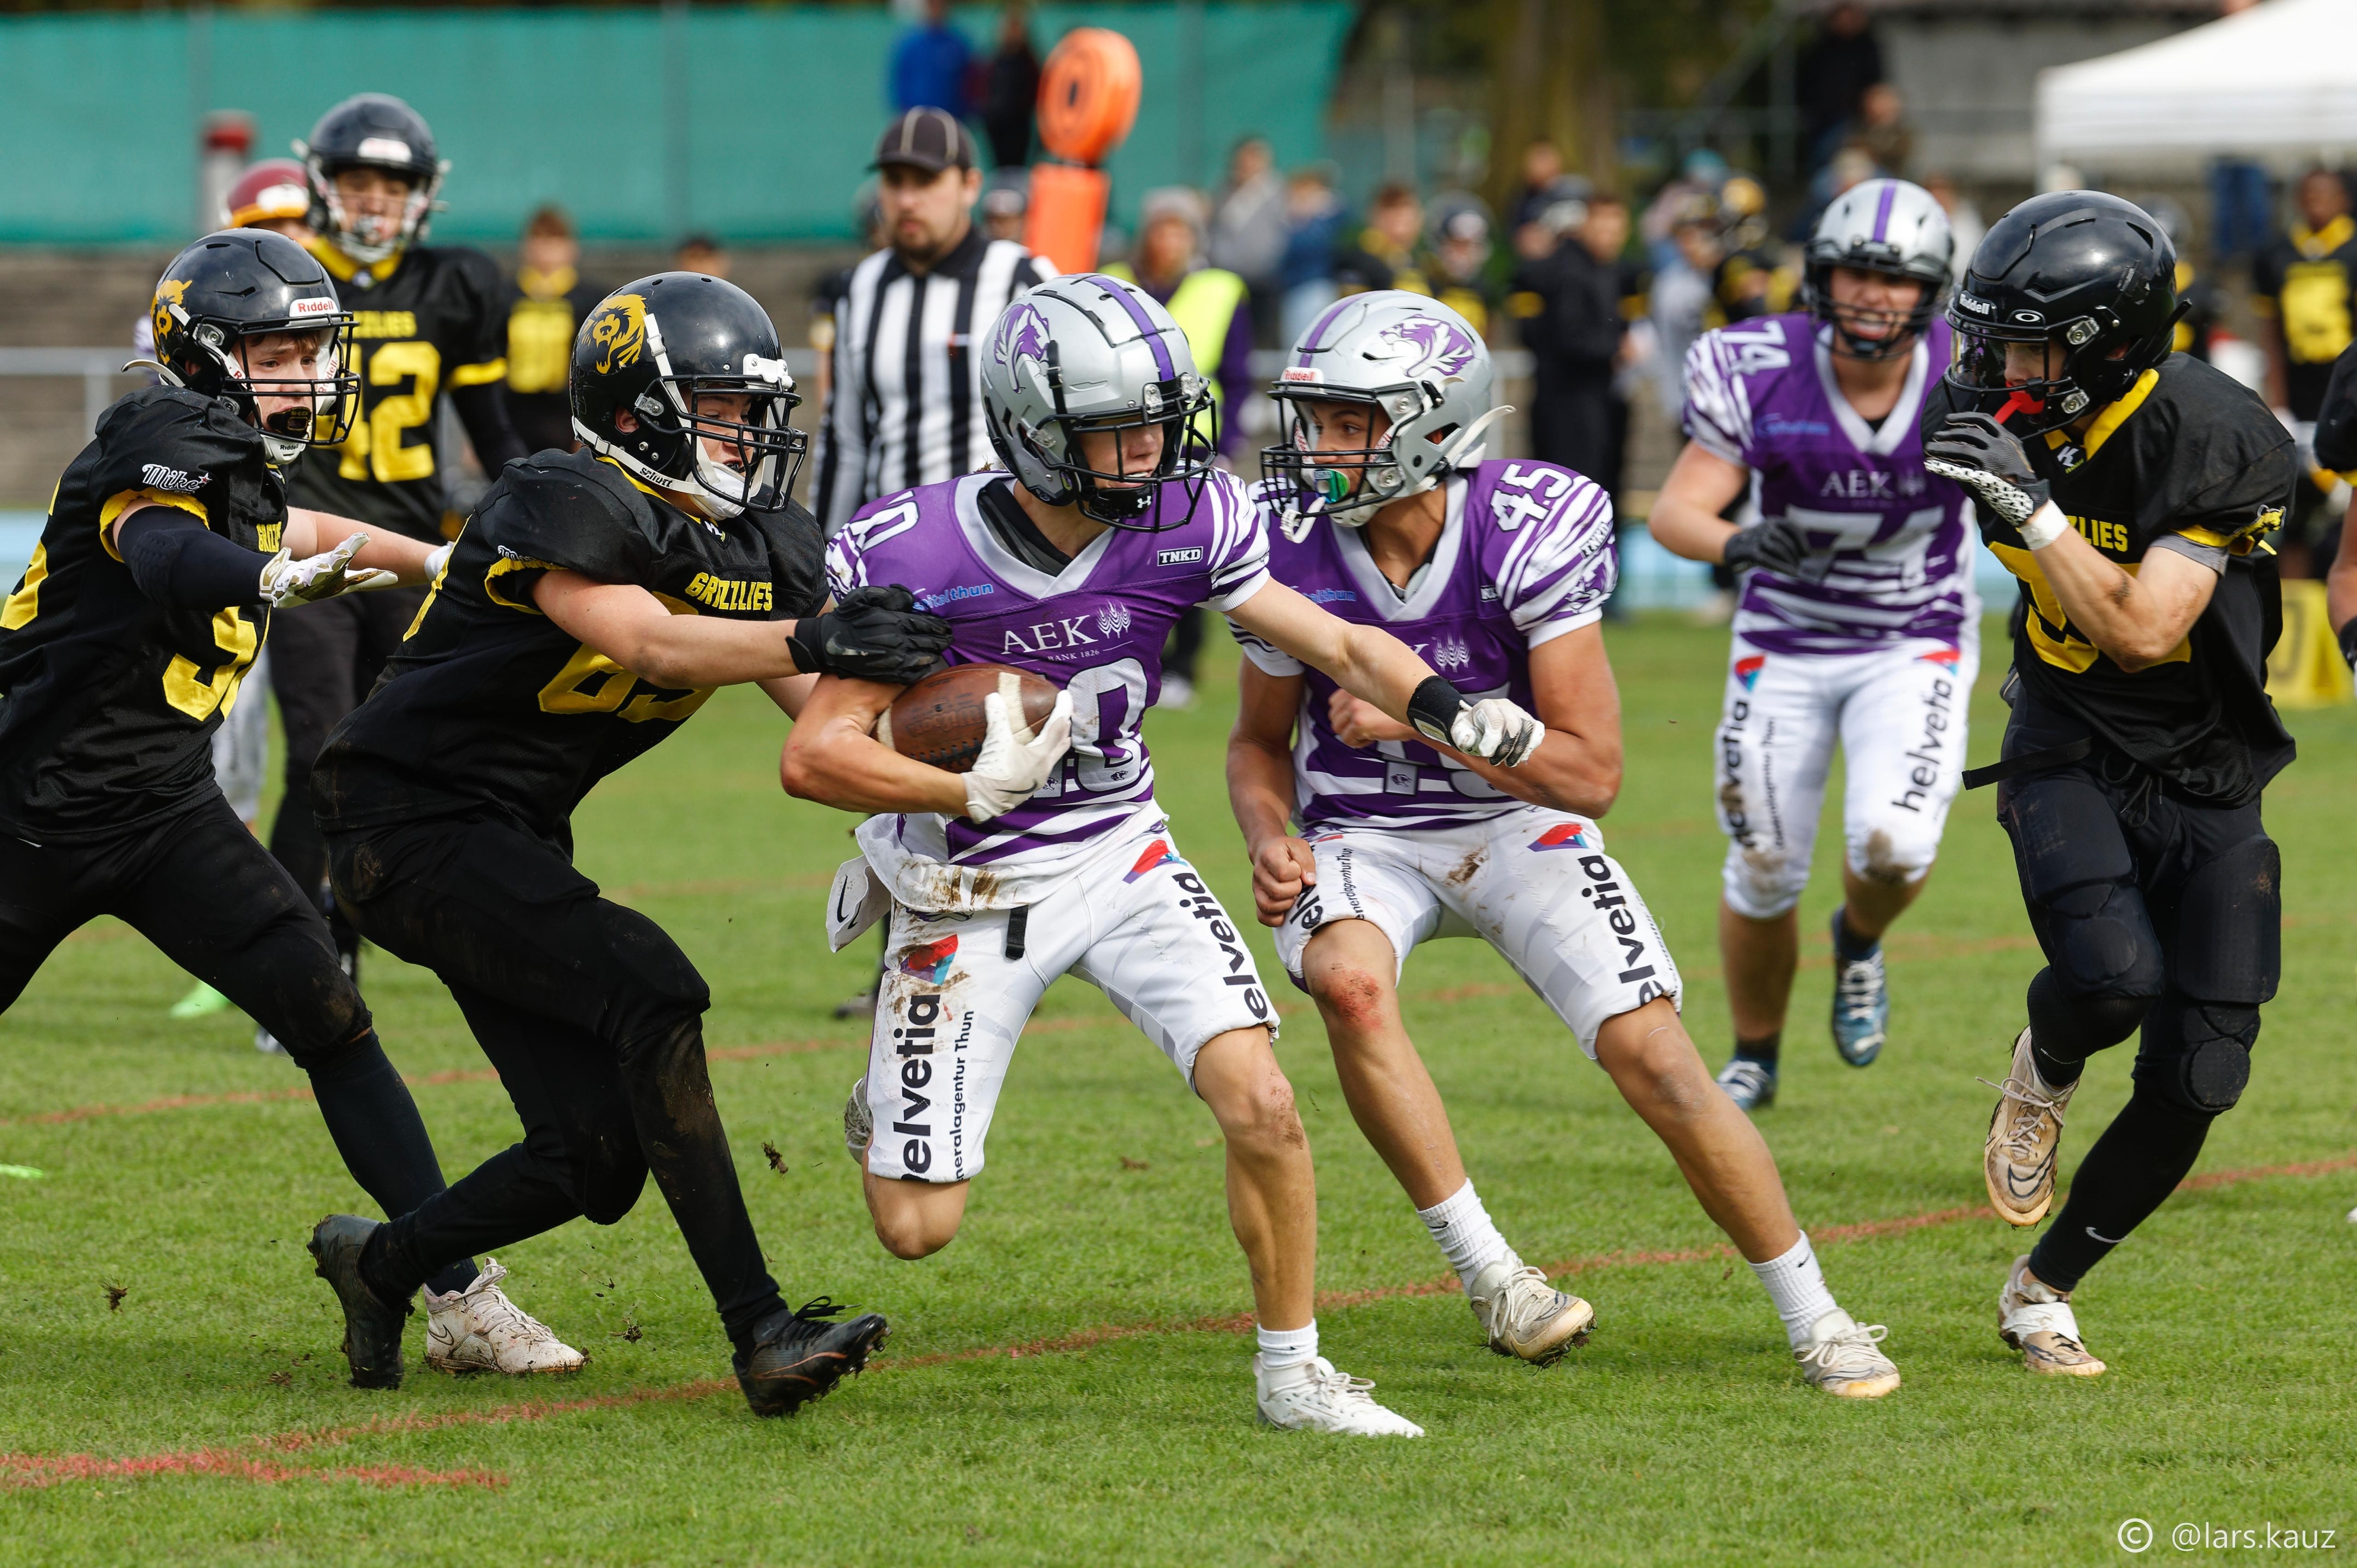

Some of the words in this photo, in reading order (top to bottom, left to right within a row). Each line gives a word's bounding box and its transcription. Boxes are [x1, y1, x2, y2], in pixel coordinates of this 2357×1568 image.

[298, 301, 334, 312] Riddell
[142, 463, 200, 491] Mike
[1490, 463, 1574, 533] 45
[1159, 549, 1202, 564] TNKD
[685, 572, 773, 611] GRIZZLIES
[1001, 614, 1098, 655] AEK
[1048, 652, 1078, 662] BANK
[1080, 649, 1100, 658] 1826
[1172, 873, 1268, 1020] elvetia
[954, 1011, 975, 1053] Thun
